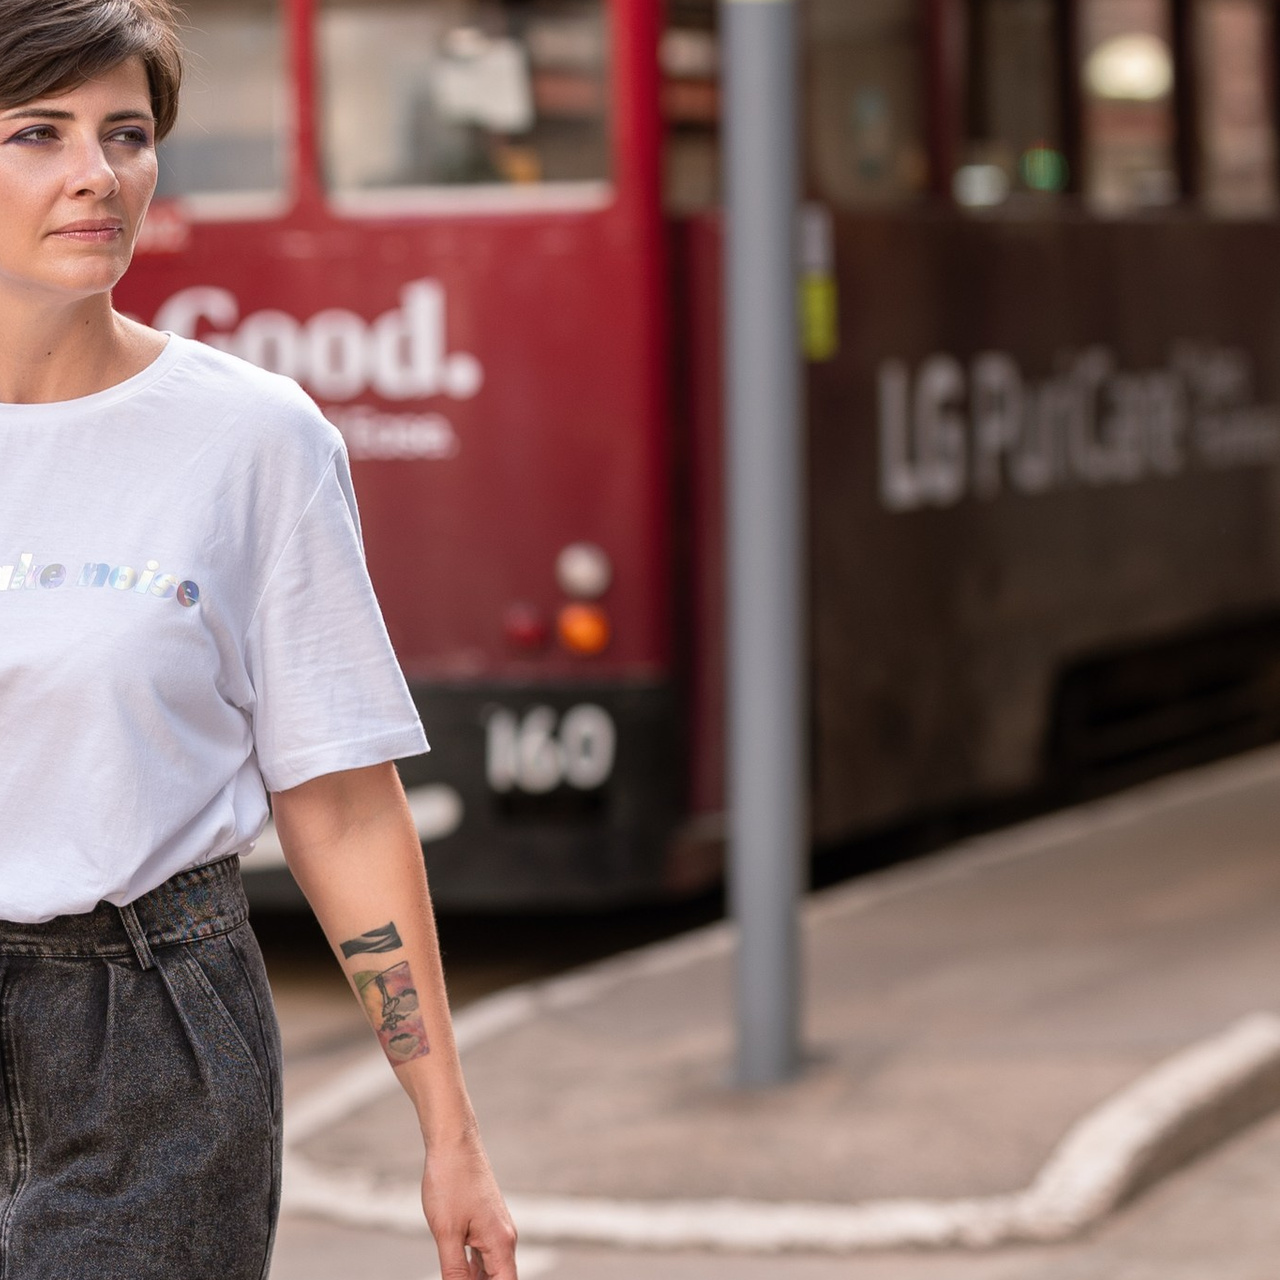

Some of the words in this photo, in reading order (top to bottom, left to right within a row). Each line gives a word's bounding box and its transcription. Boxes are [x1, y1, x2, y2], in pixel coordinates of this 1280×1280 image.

[156, 278, 483, 400] Good.
[878, 344, 967, 510] LG
[76, 560, 200, 607] noise
[486, 702, 617, 794] 160
